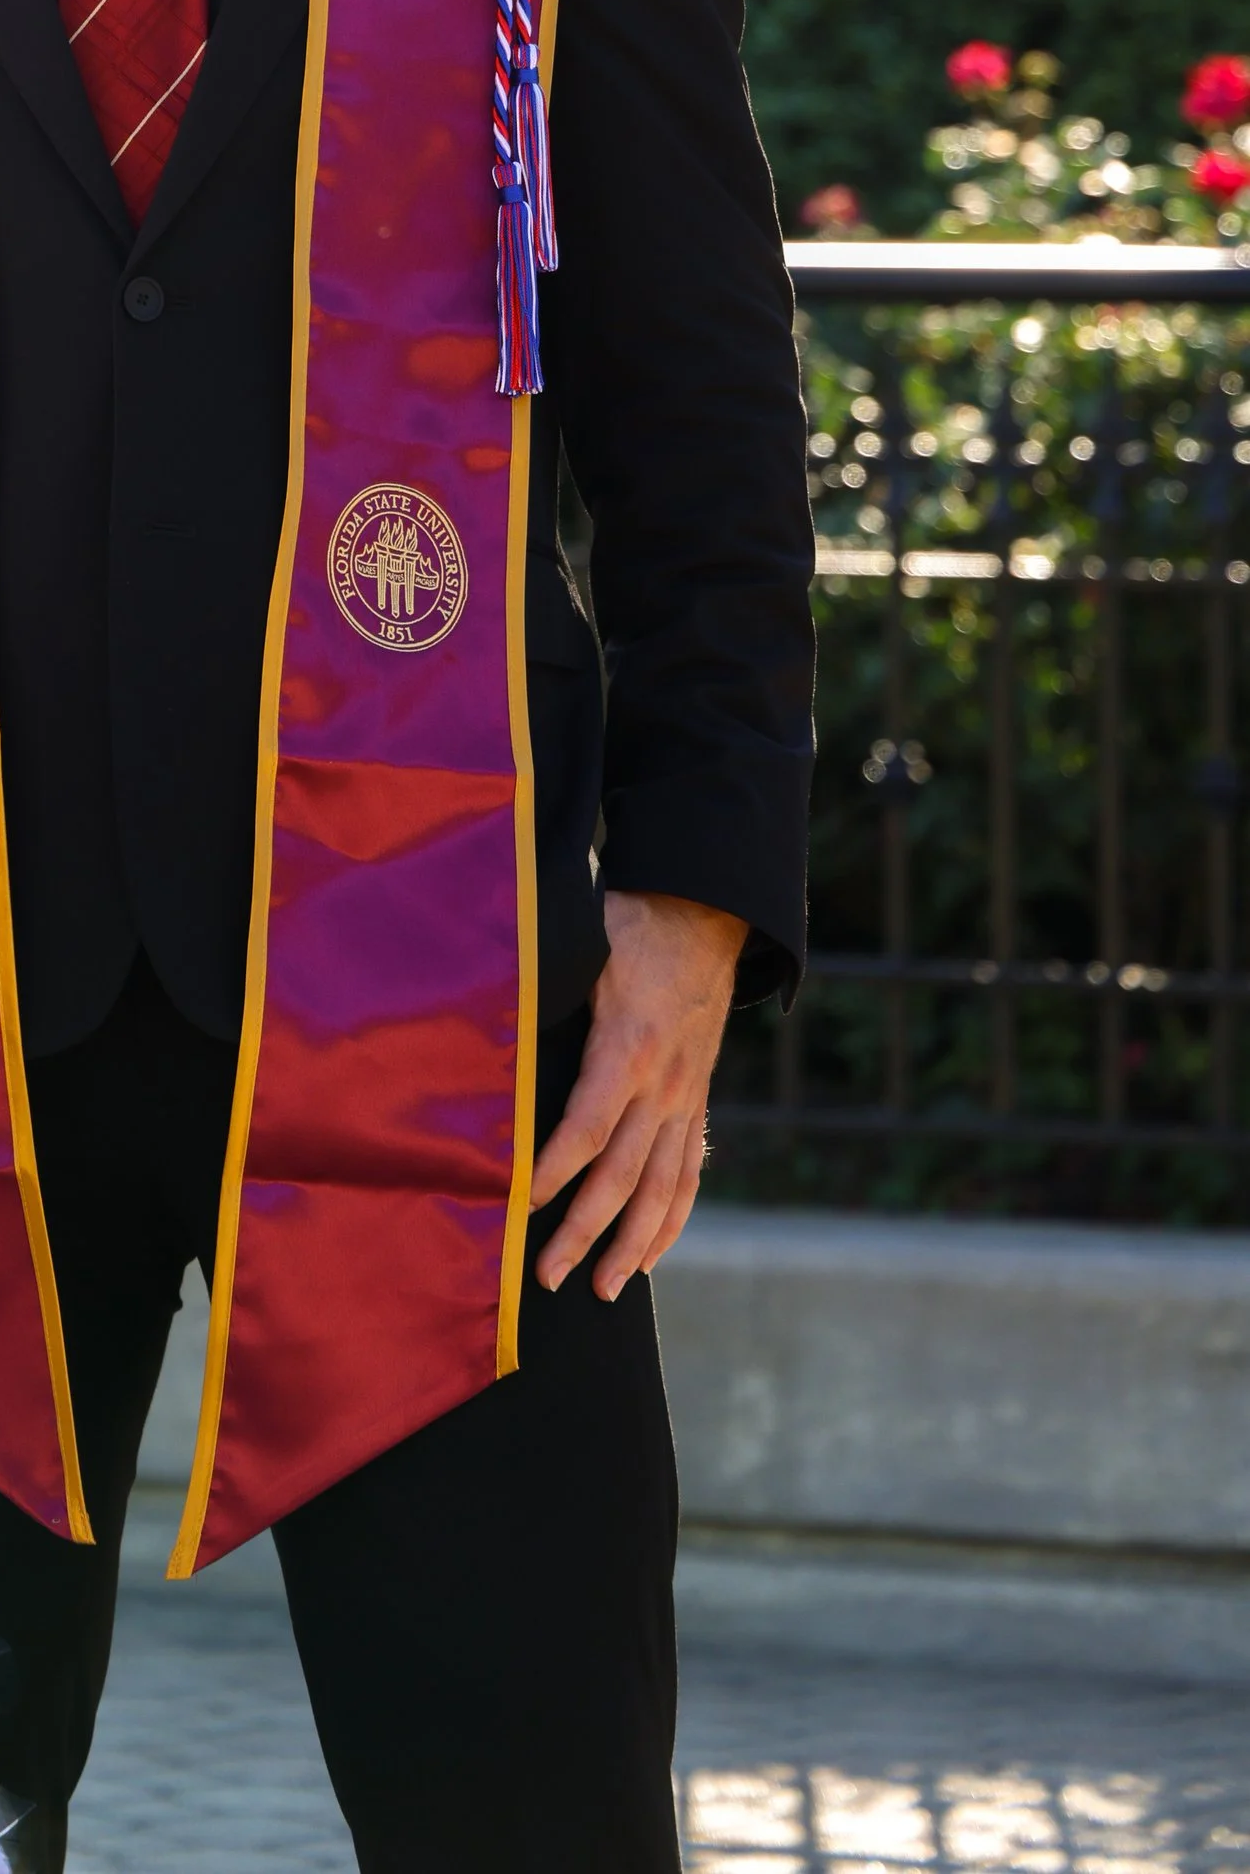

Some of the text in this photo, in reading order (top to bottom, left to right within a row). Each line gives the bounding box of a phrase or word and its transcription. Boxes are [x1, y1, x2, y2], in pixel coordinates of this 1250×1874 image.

[335, 493, 459, 621] FLORIDA STATE UNIVERSITY
[377, 621, 415, 643] 1851
